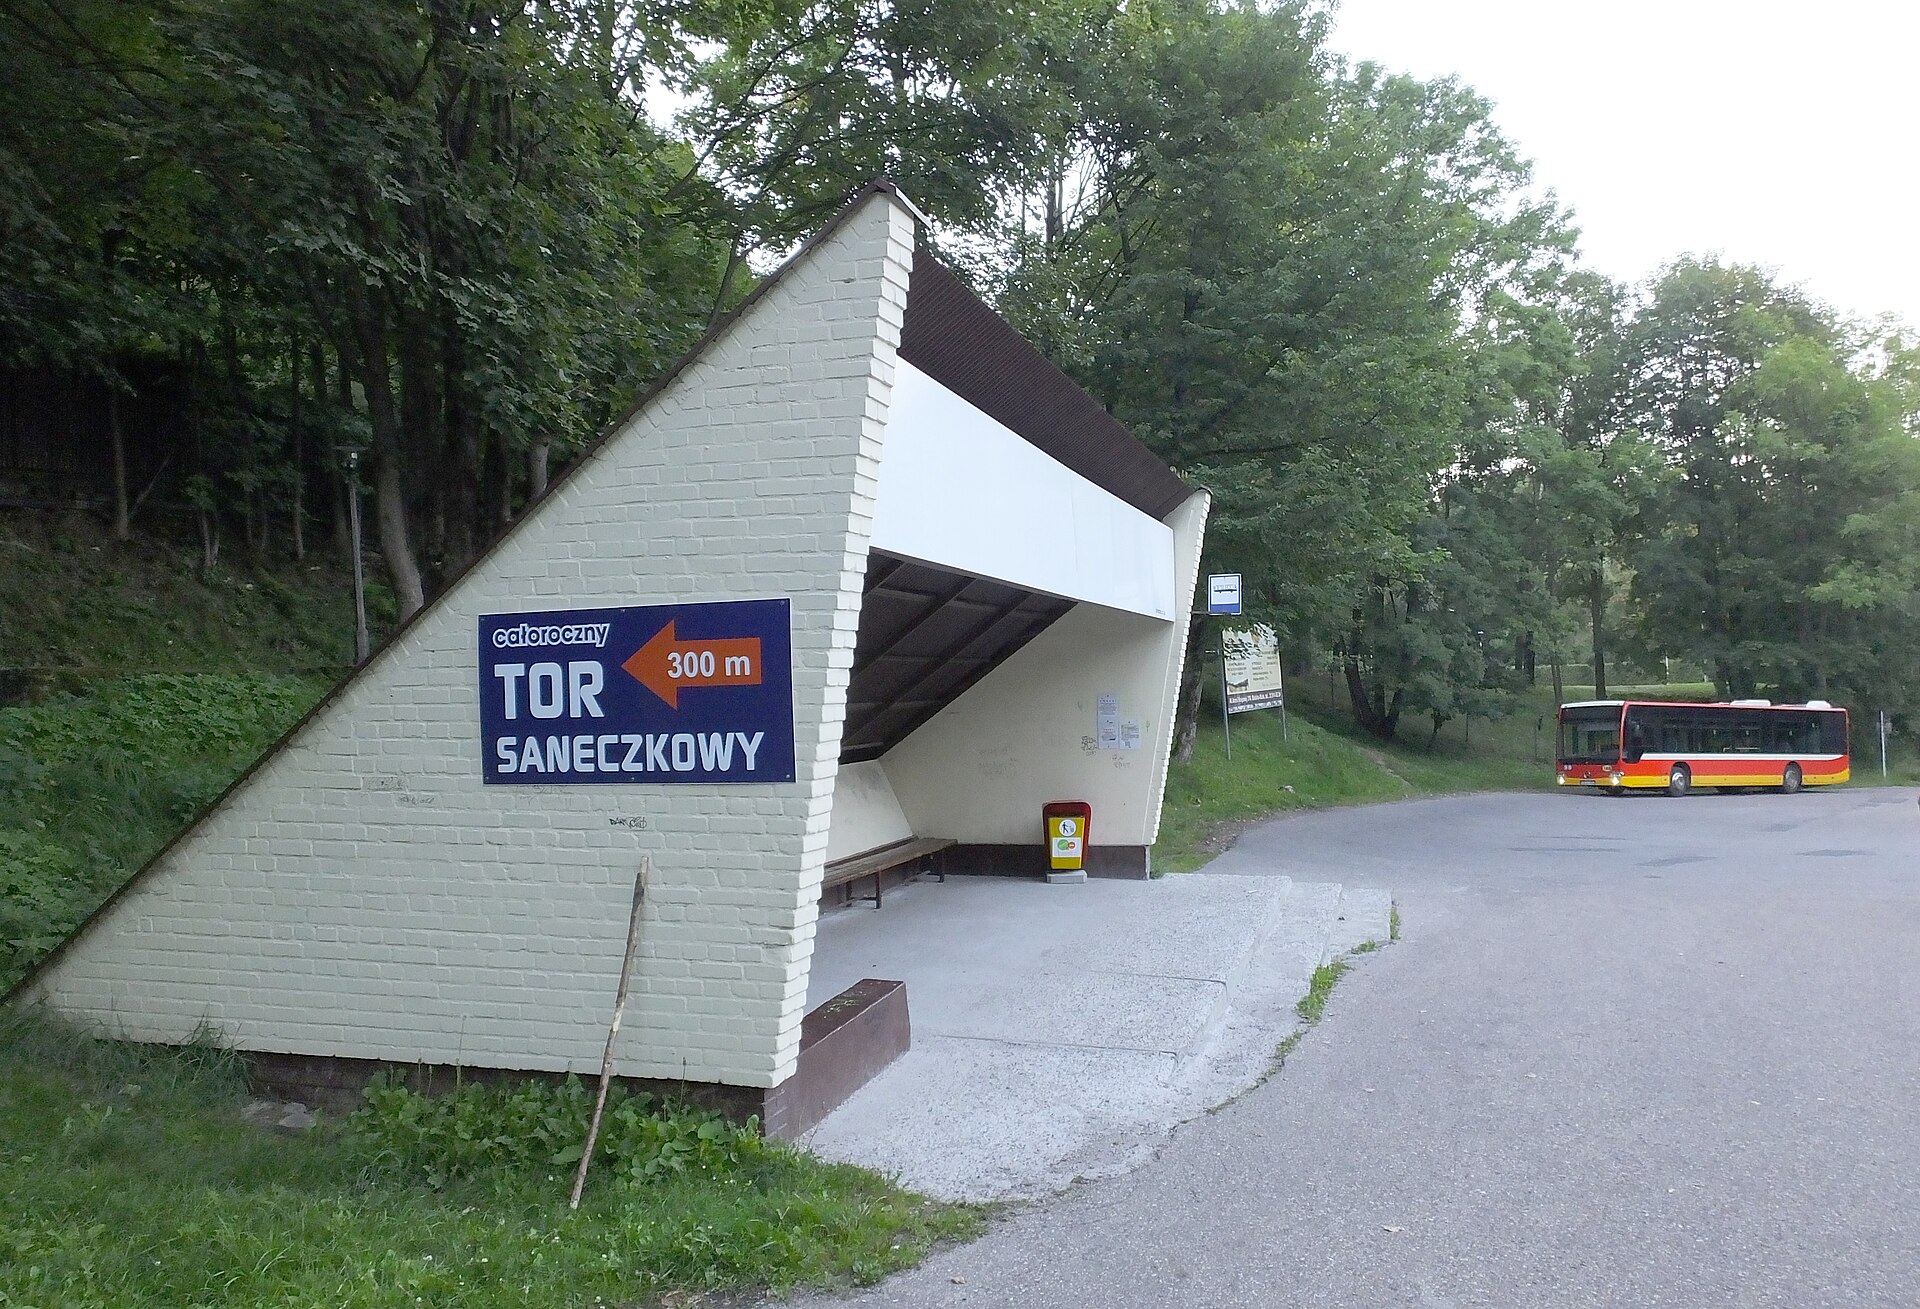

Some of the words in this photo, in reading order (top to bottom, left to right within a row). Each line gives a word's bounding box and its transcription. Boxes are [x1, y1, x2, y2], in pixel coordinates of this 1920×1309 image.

[493, 623, 610, 648] całoroczny
[667, 651, 715, 678] 300
[725, 654, 750, 676] m
[494, 660, 605, 720] TOR
[497, 732, 765, 773] SANECZKOWY
